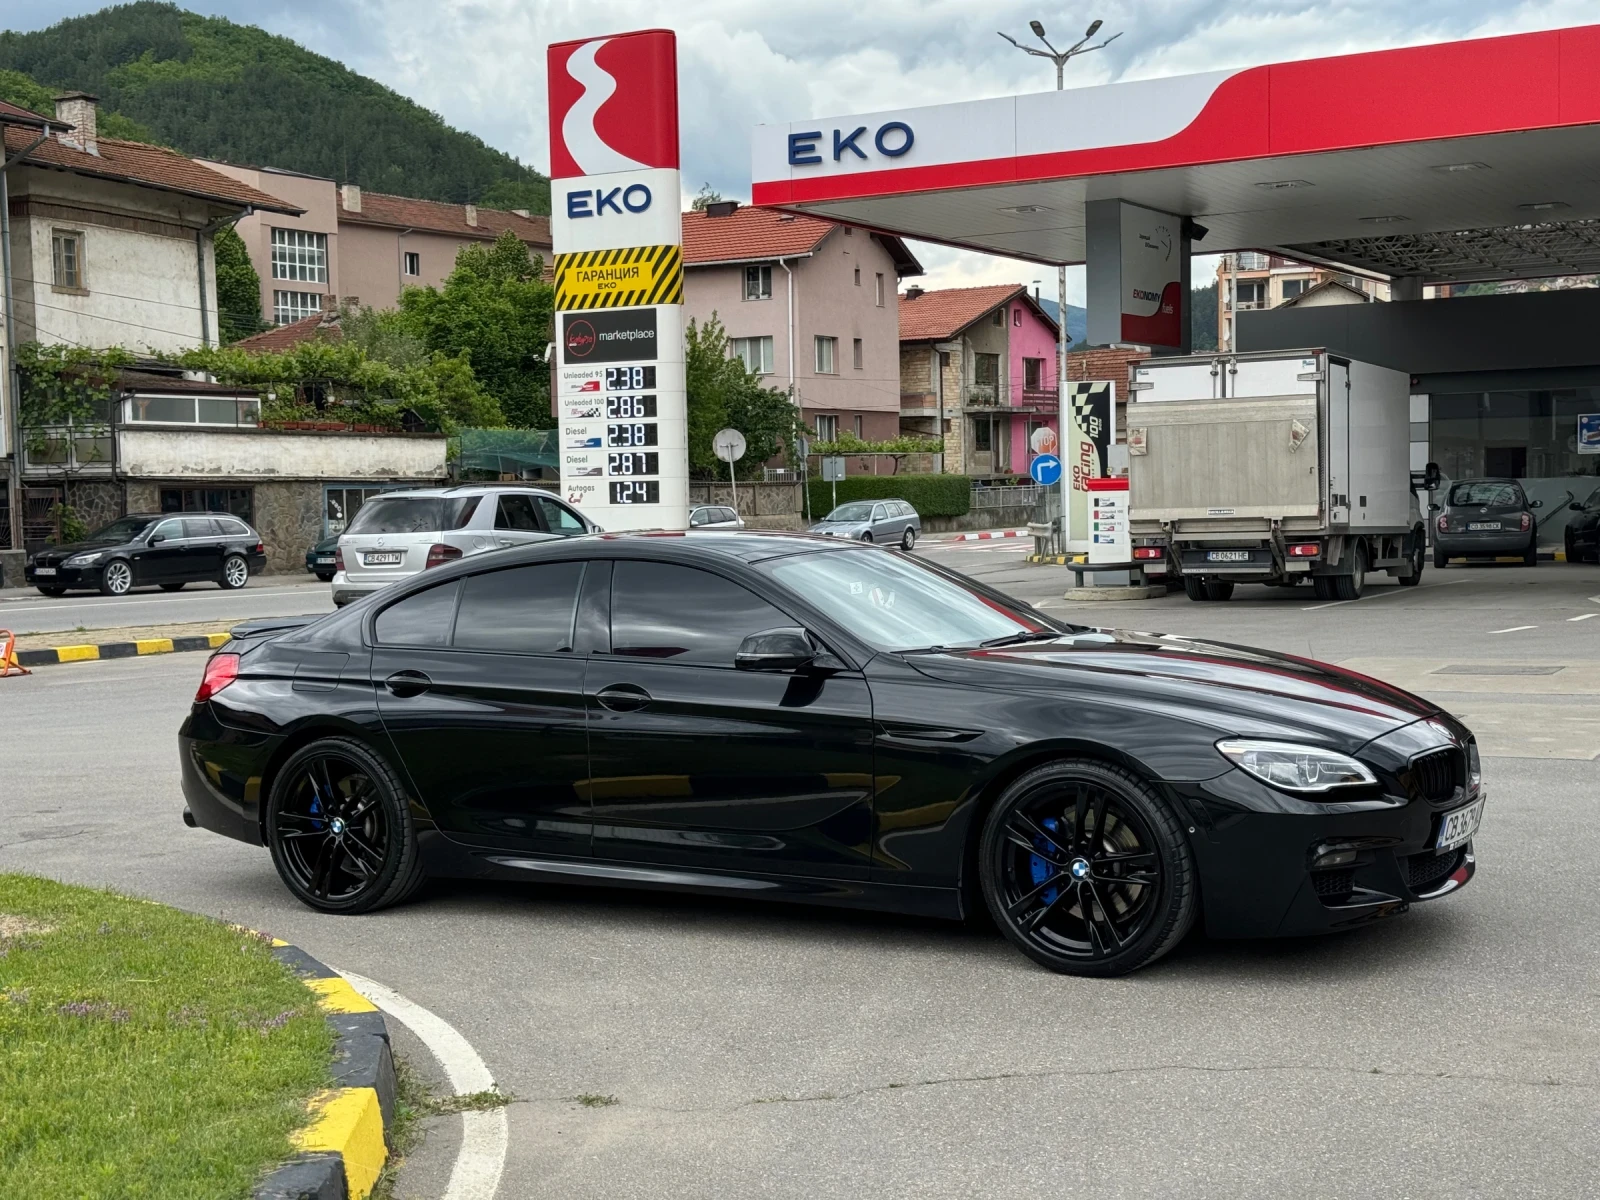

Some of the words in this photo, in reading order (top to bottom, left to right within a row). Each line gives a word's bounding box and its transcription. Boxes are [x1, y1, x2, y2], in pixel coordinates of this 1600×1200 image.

[788, 121, 915, 166] EKO
[567, 183, 652, 219] EKO
[576, 266, 639, 283] ГАРАНЦИЯ
[597, 281, 617, 290] EKO
[598, 328, 655, 342] marketplace
[563, 371, 594, 379] Unleaded
[594, 370, 603, 378] 95
[607, 367, 644, 390] 2.38
[564, 398, 593, 407] Unleaded
[593, 398, 605, 406] 100
[607, 396, 645, 418] 2.86
[565, 426, 588, 436] Diesel
[608, 424, 646, 447] 2.38
[1089, 415, 1099, 439] 100
[566, 454, 589, 464] Diesel
[609, 452, 647, 475] 2.87
[1080, 441, 1095, 493] racing
[1073, 465, 1081, 491] EKO
[567, 484, 595, 494] Autogas
[616, 481, 647, 504] 1.24
[367, 554, 376, 563] CB
[376, 554, 391, 562] 4291
[1445, 815, 1459, 841] CB
